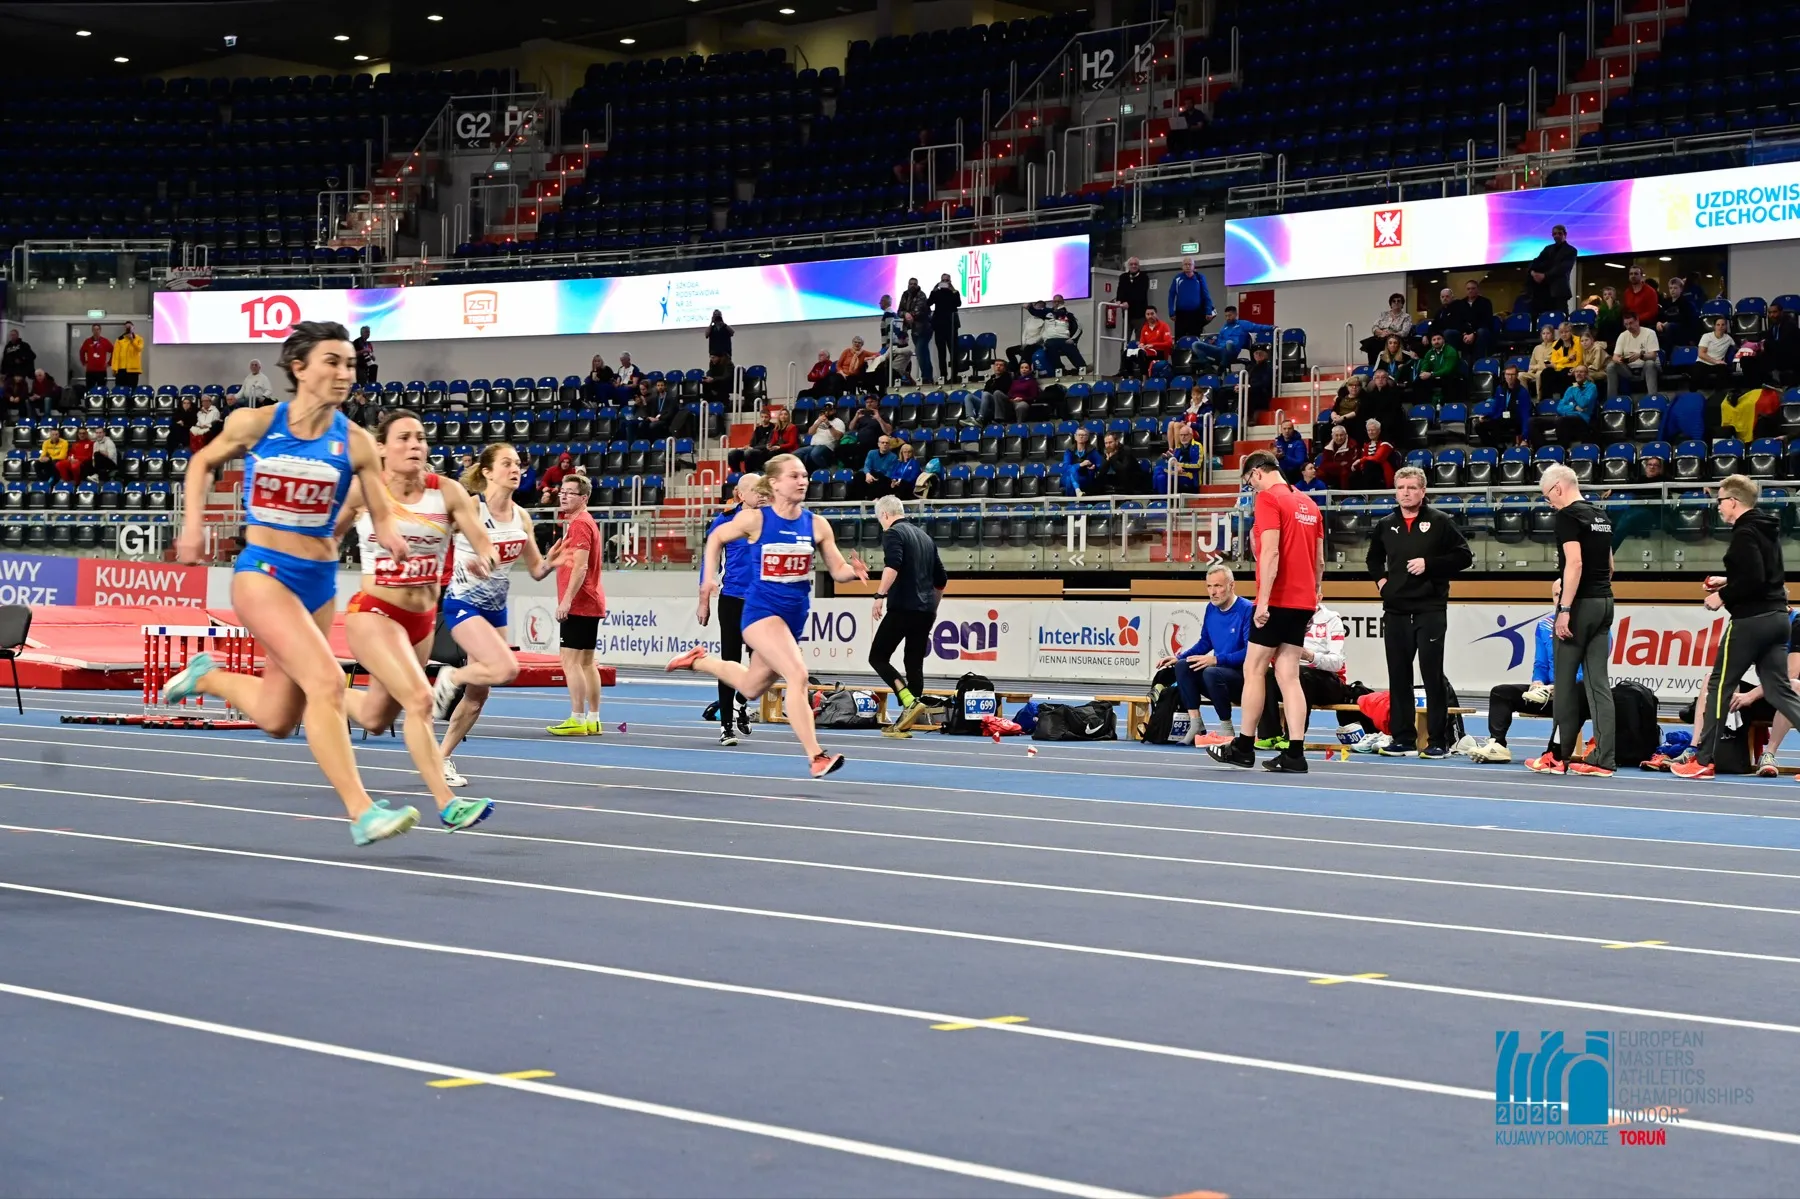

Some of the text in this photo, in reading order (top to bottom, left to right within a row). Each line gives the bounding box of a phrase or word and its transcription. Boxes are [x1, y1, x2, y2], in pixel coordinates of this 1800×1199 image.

[1082, 49, 1114, 81] H2
[456, 112, 491, 139] G2
[1696, 183, 1800, 210] UZDROWIS
[1695, 203, 1800, 229] CIECHOCIN
[254, 301, 292, 331] LO
[468, 299, 493, 311] ZST
[256, 476, 334, 505] 40 1424
[119, 525, 156, 556] G1
[203, 525, 212, 556] 1
[1198, 512, 1232, 553] J1
[503, 542, 522, 559] 560
[0, 560, 42, 582] WY
[400, 558, 438, 579] 2817
[764, 555, 780, 566] 40
[784, 556, 807, 571] 415
[95, 566, 187, 592] KUJAWY
[602, 610, 657, 631] Związek
[595, 635, 721, 656] ej Atletyki Masters
[1038, 625, 1115, 647] InterRisk
[1607, 616, 1724, 667] lani
[799, 647, 854, 658] OUP
[1038, 656, 1141, 667] VIENNA INSURANCE GROUP
[966, 699, 994, 711] 60 699
[1173, 721, 1183, 729] 60
[1347, 731, 1362, 743] 301
